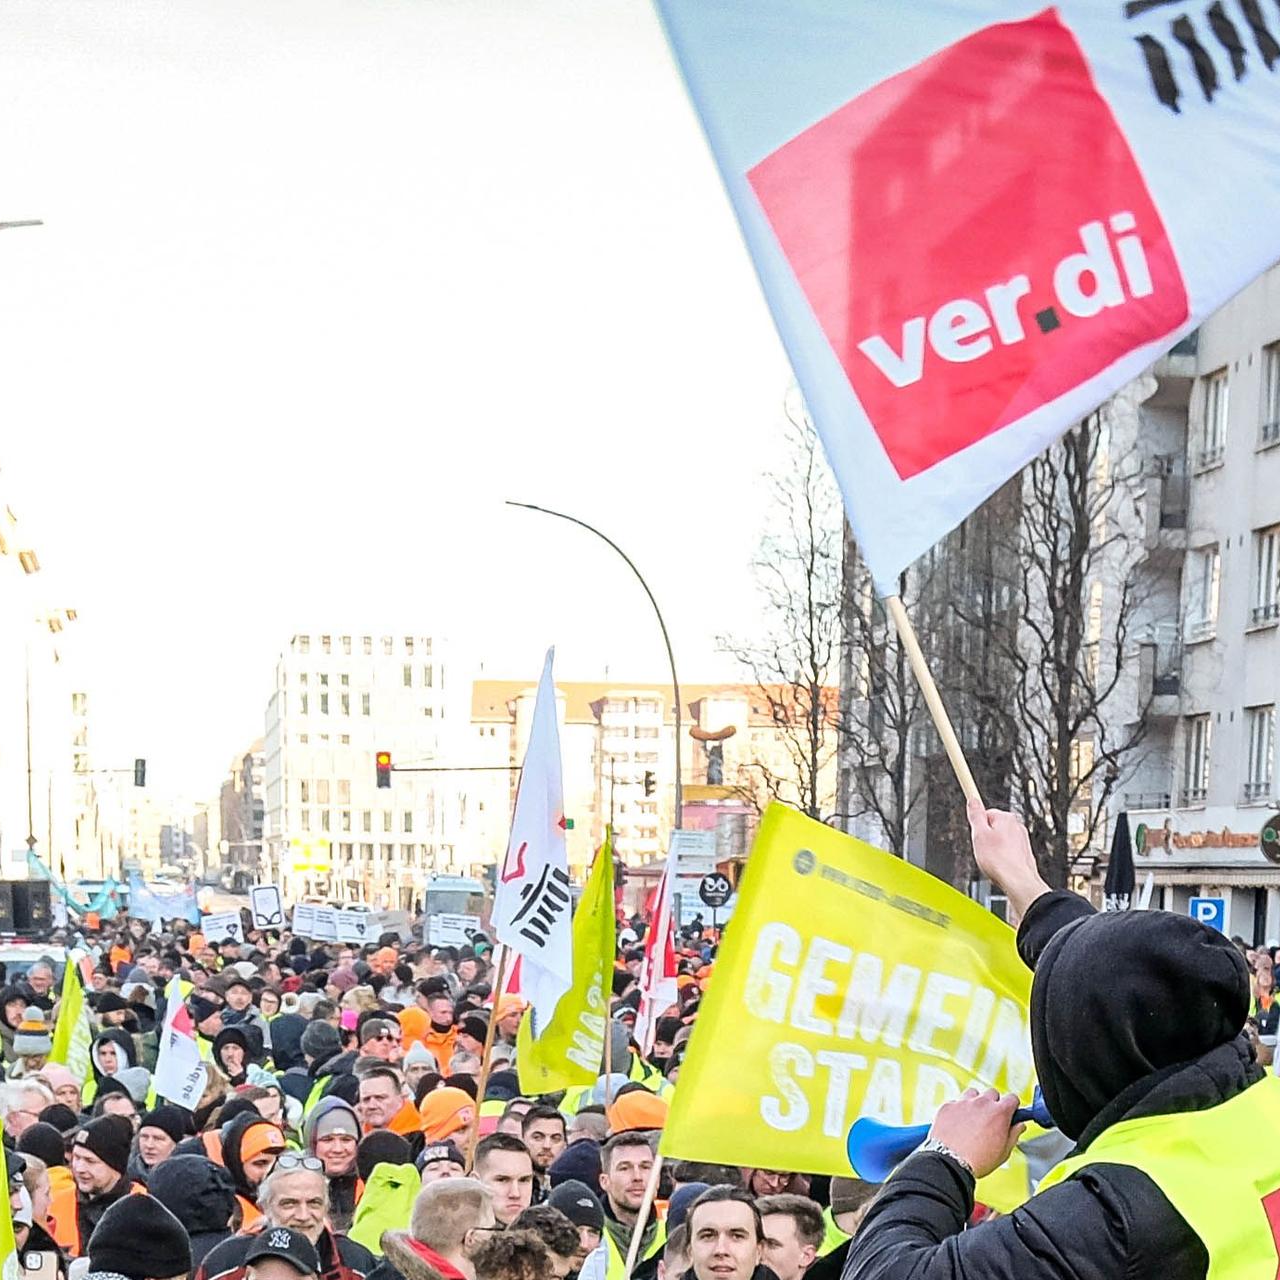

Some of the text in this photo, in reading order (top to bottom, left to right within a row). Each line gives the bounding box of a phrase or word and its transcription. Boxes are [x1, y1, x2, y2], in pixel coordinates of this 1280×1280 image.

[856, 210, 1155, 389] ver.di
[1197, 903, 1218, 921] P
[759, 1041, 992, 1138] STAR
